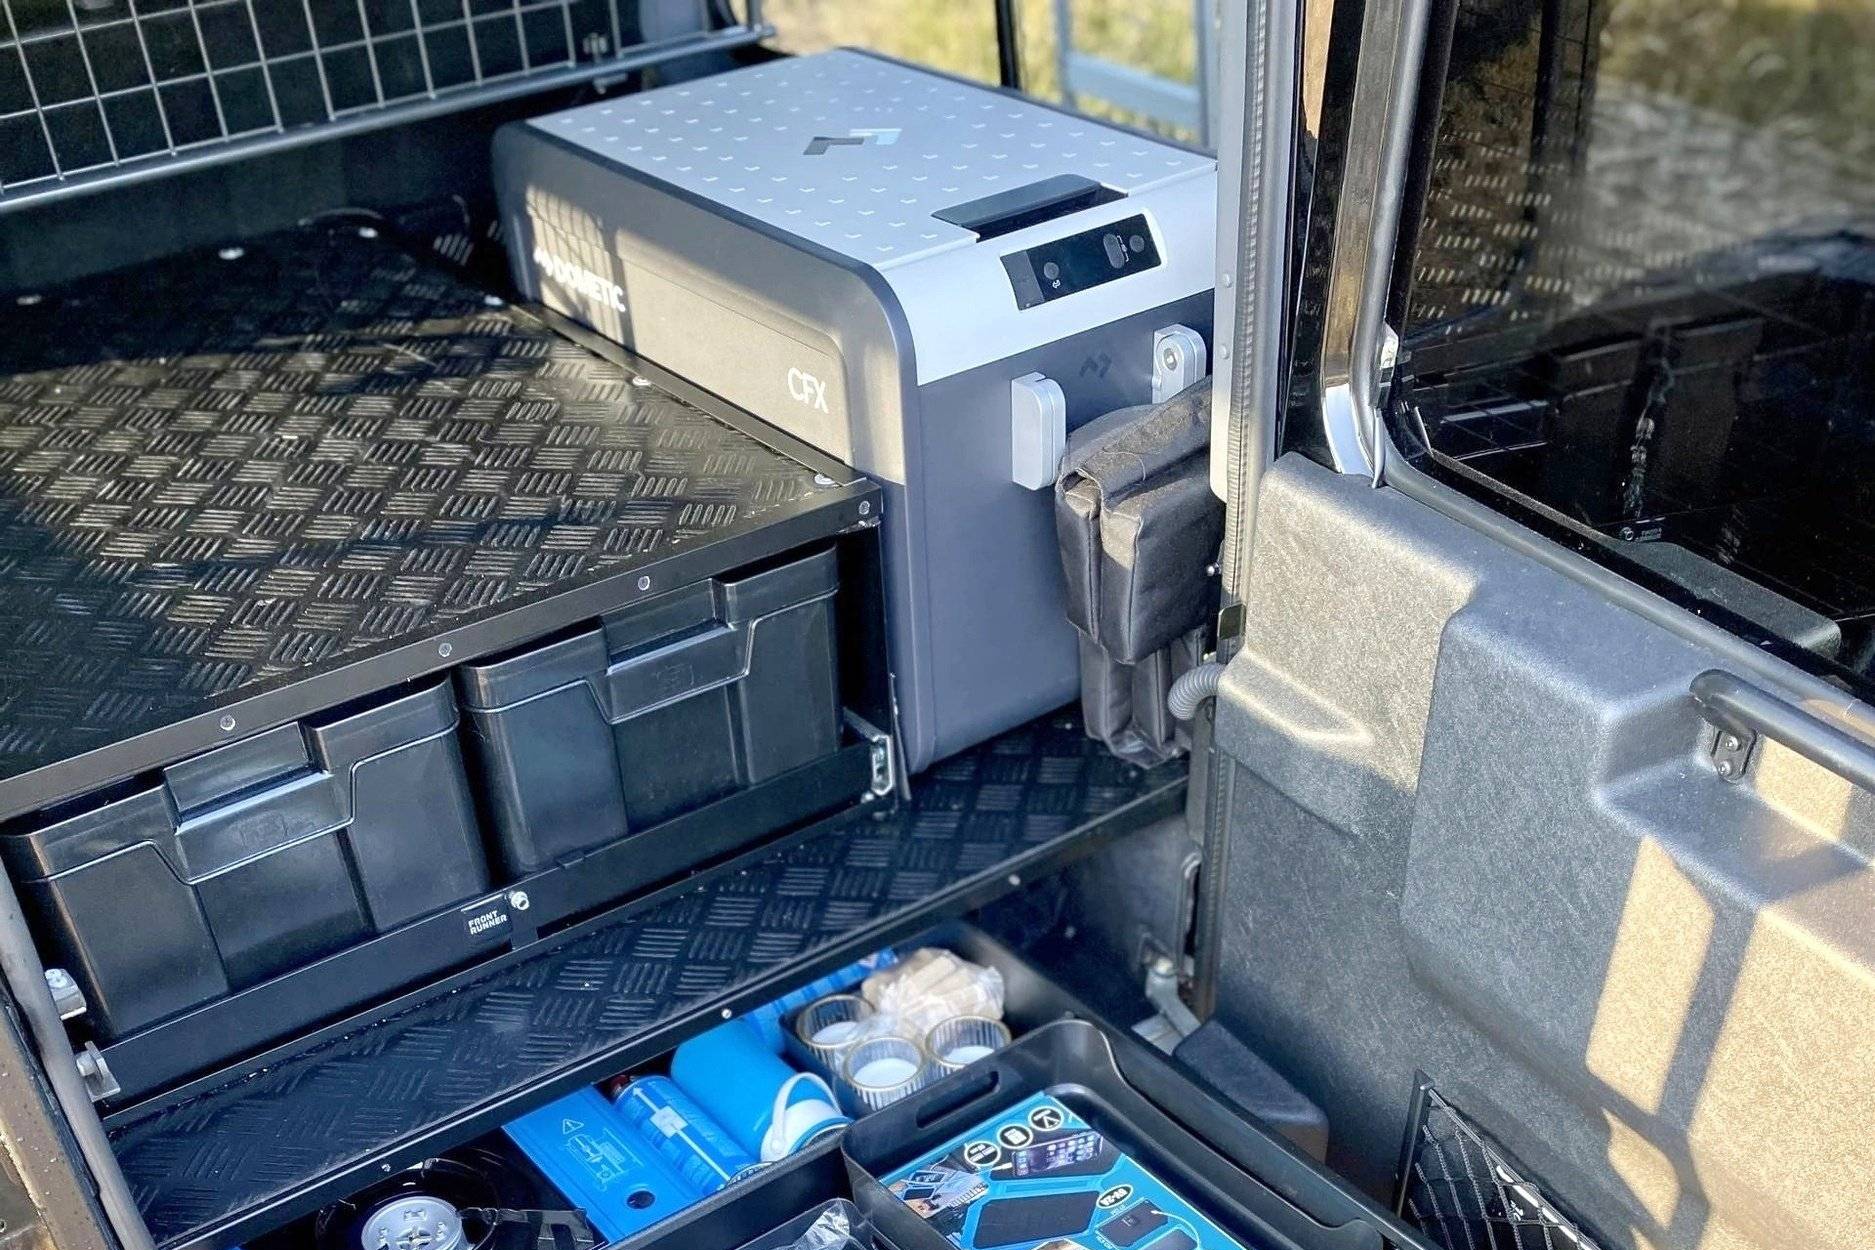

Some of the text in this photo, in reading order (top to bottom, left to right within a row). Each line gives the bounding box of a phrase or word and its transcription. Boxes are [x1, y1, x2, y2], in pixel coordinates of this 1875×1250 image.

[552, 254, 626, 312] DOMETIC
[787, 367, 829, 414] CFX
[468, 910, 498, 928] FRONT
[470, 914, 508, 936] RUNNER
